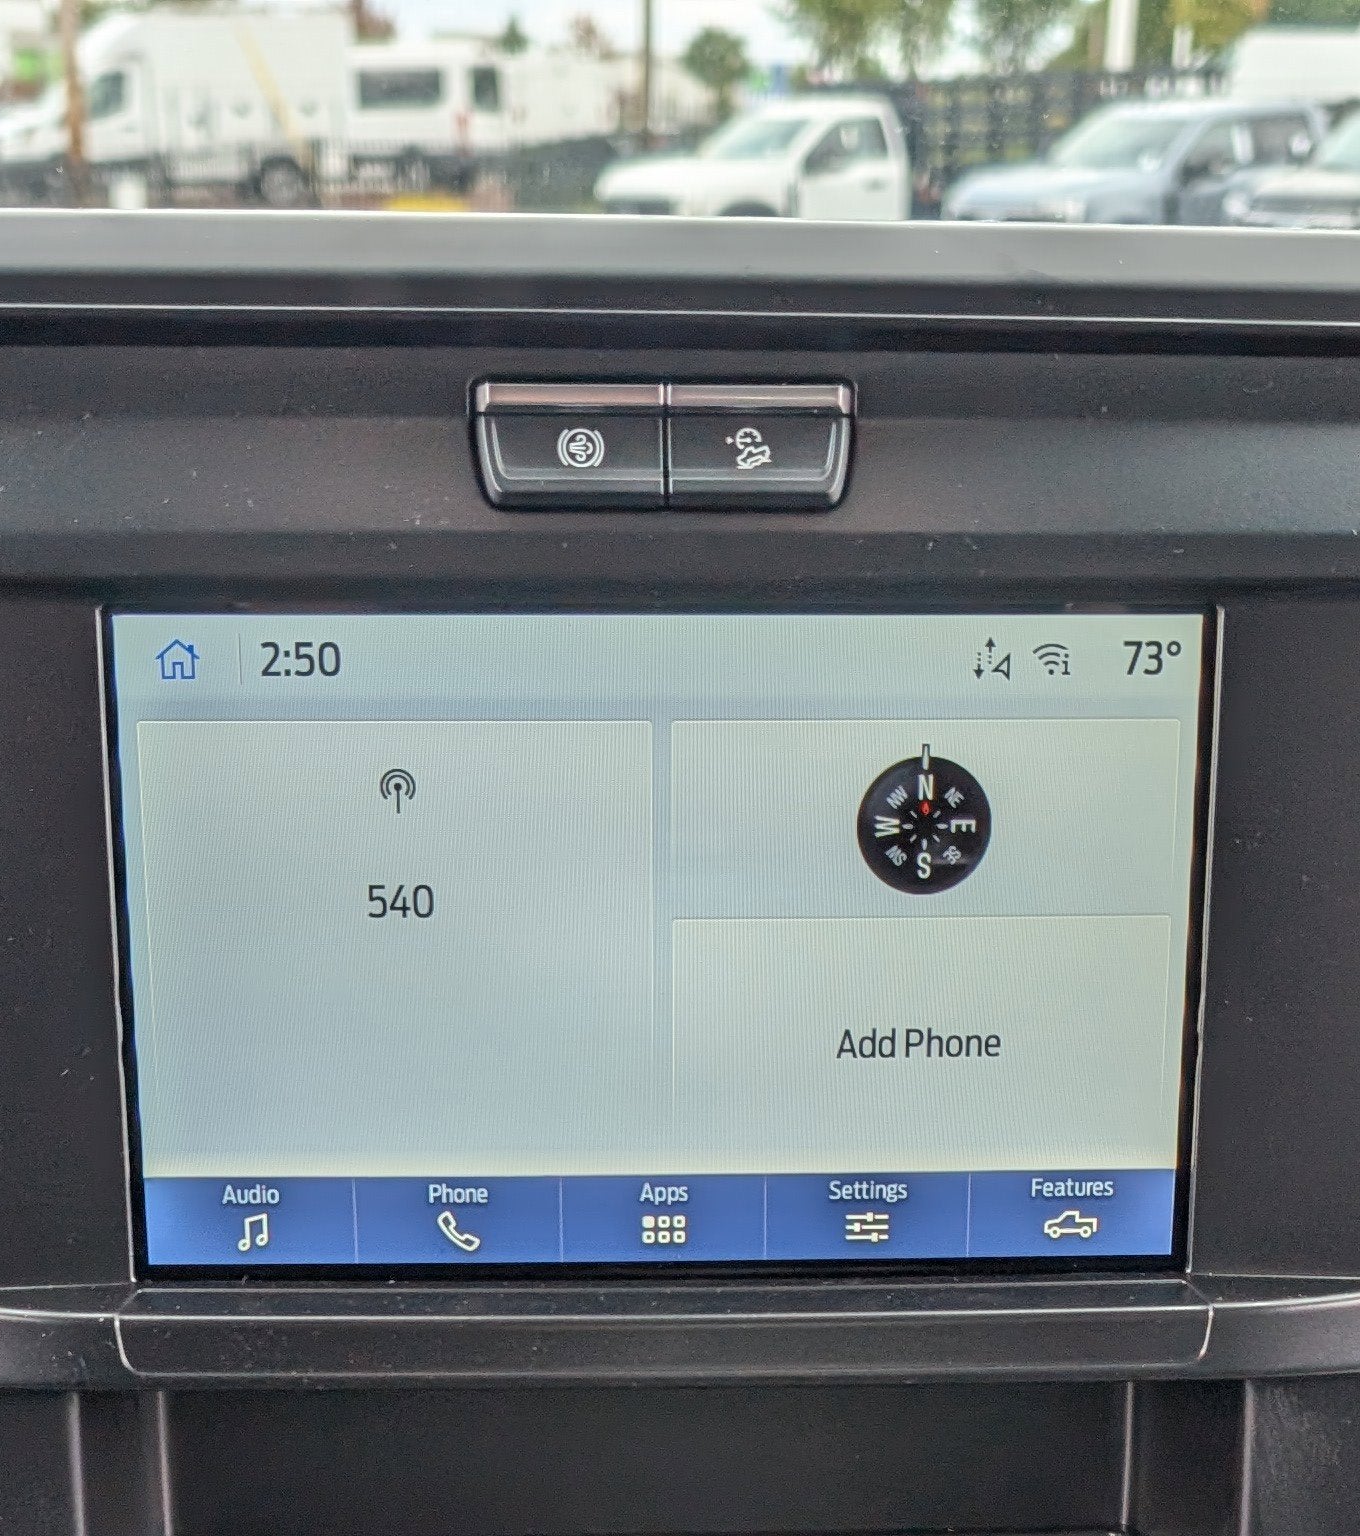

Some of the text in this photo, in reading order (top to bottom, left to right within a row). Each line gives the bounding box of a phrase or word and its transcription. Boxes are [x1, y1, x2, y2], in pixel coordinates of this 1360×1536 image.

[260, 641, 342, 678] 2:50
[1123, 640, 1182, 676] 73°
[918, 774, 934, 800] N
[944, 787, 965, 808] NE
[874, 815, 900, 838] W
[950, 819, 976, 833] E
[917, 852, 932, 879] S
[367, 883, 435, 919] 540
[836, 1027, 1001, 1058] Add Phone
[222, 1184, 280, 1204] Audio
[428, 1183, 488, 1204] Phone
[639, 1182, 688, 1207] Apps
[828, 1180, 908, 1203] Settings
[1031, 1178, 1113, 1197] Features
